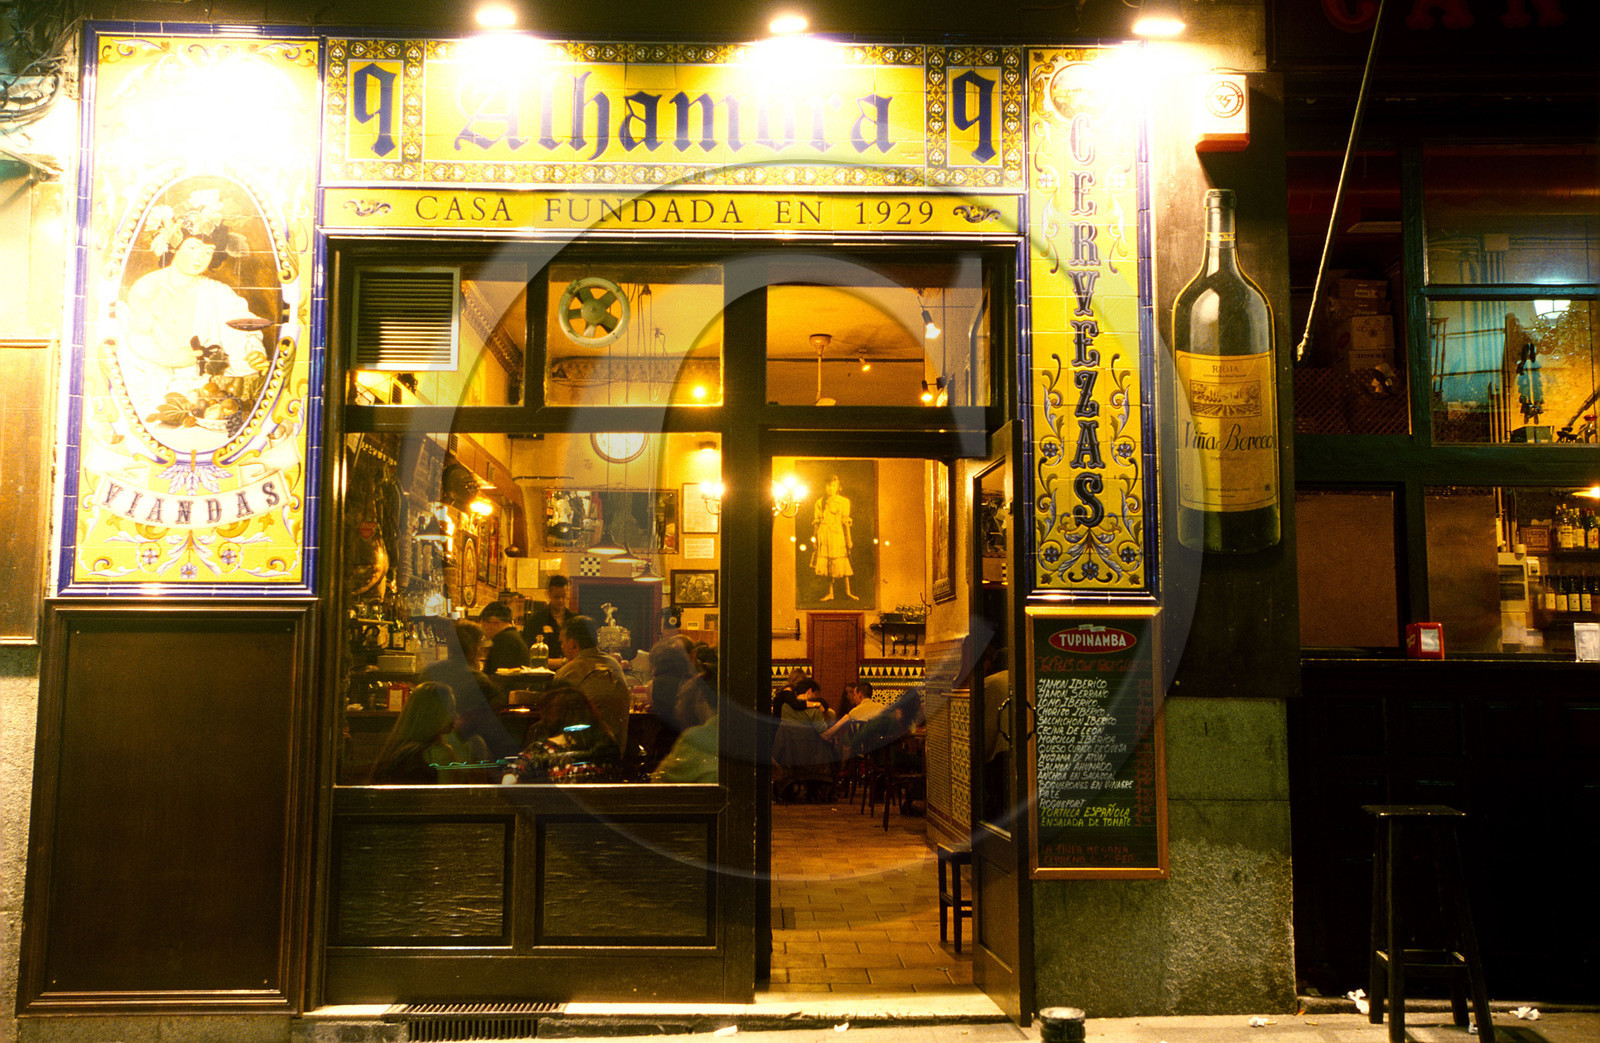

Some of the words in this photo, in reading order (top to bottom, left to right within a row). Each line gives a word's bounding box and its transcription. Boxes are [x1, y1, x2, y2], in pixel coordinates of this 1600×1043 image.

[453, 68, 897, 161] Alhambra
[415, 196, 513, 222] CASA
[544, 198, 743, 224] FUNDADA
[775, 200, 823, 225] EN
[855, 200, 934, 226] 1929
[1068, 113, 1106, 529] CERVEZAS
[1181, 419, 1216, 451] Viña
[102, 480, 281, 525] VIANDAS
[1058, 633, 1127, 647] TUPINAMBA
[1066, 726, 1080, 735] DE
[1041, 807, 1080, 817] TORTILLA
[1083, 803, 1130, 818] ESPAÑOLA
[1041, 817, 1084, 827] ENSALADA
[1103, 816, 1132, 827] TOMATE
